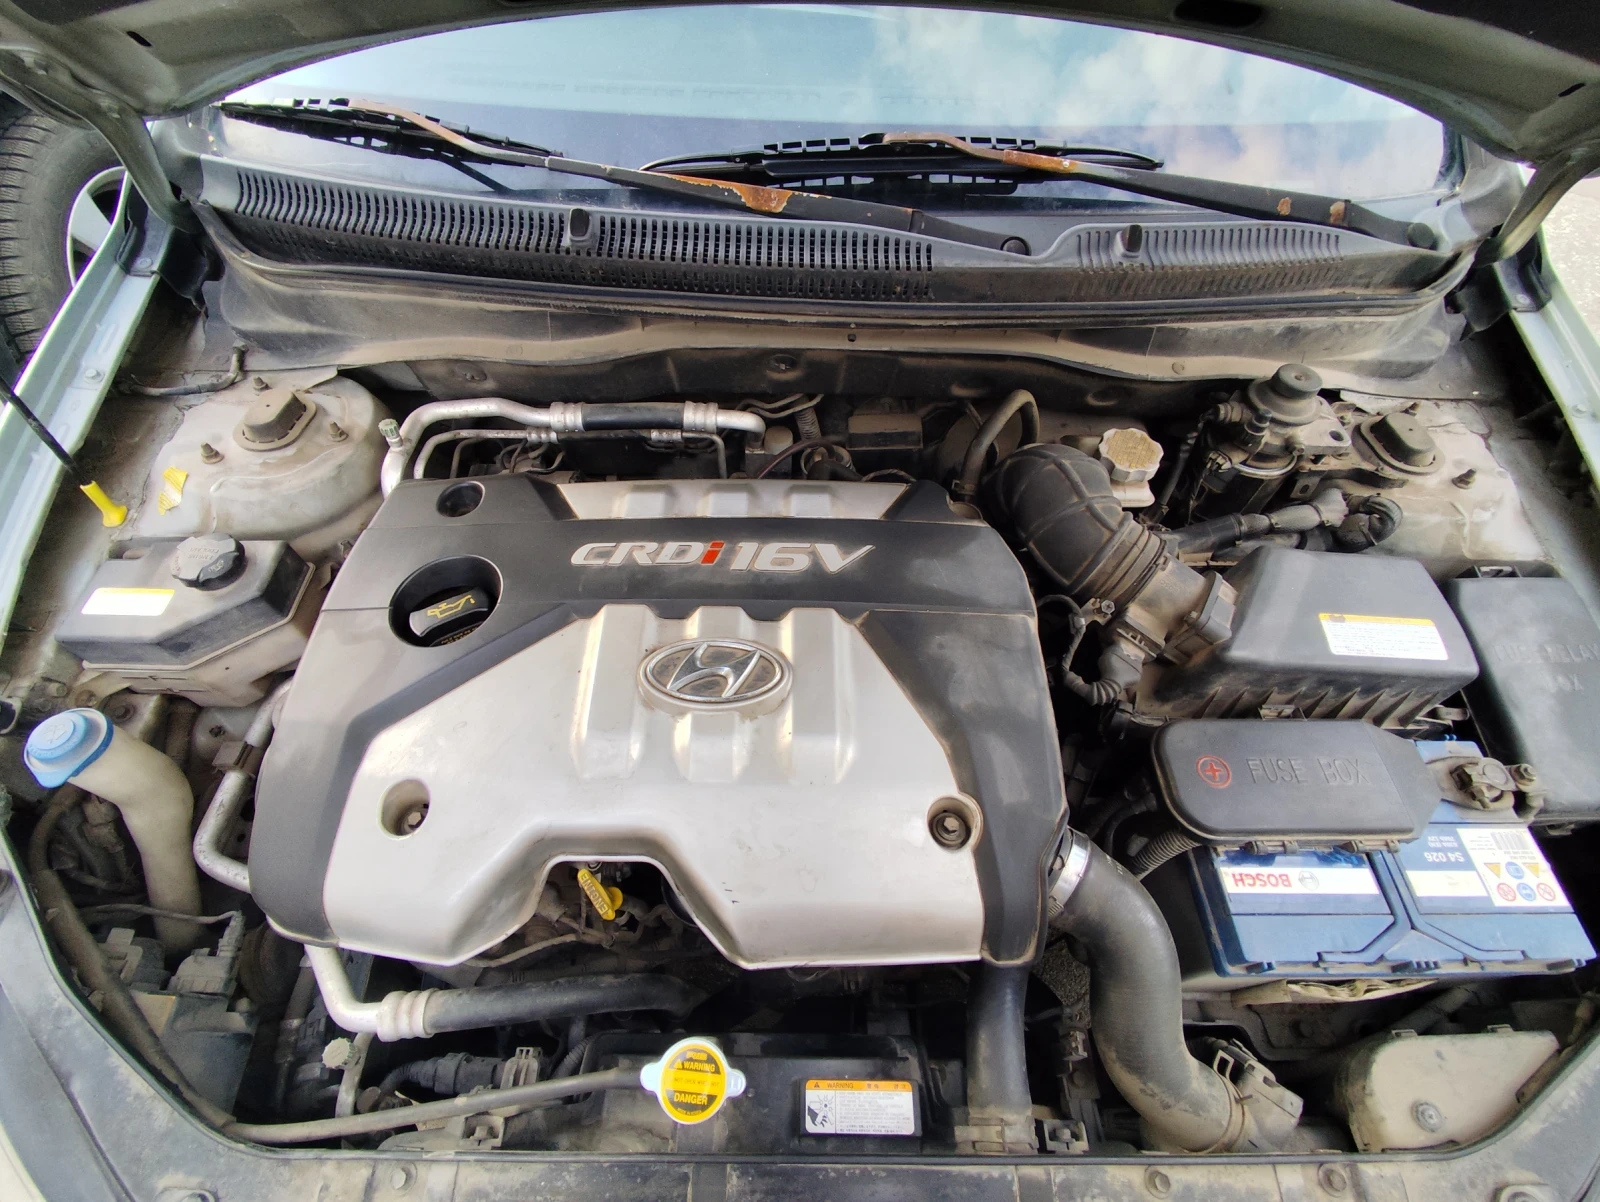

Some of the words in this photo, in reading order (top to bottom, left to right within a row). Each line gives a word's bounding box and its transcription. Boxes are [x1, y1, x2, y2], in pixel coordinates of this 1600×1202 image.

[571, 541, 724, 566] CRDi
[730, 542, 876, 574] 16V
[1245, 757, 1307, 784] FUSE
[1316, 757, 1372, 785] BOX
[1423, 852, 1447, 863] 026
[1447, 852, 1465, 863] S4
[1231, 872, 1293, 888] BOSCH
[580, 873, 609, 915] ENGINE
[684, 1061, 715, 1071] WARNING
[673, 1092, 707, 1105] DANGER
